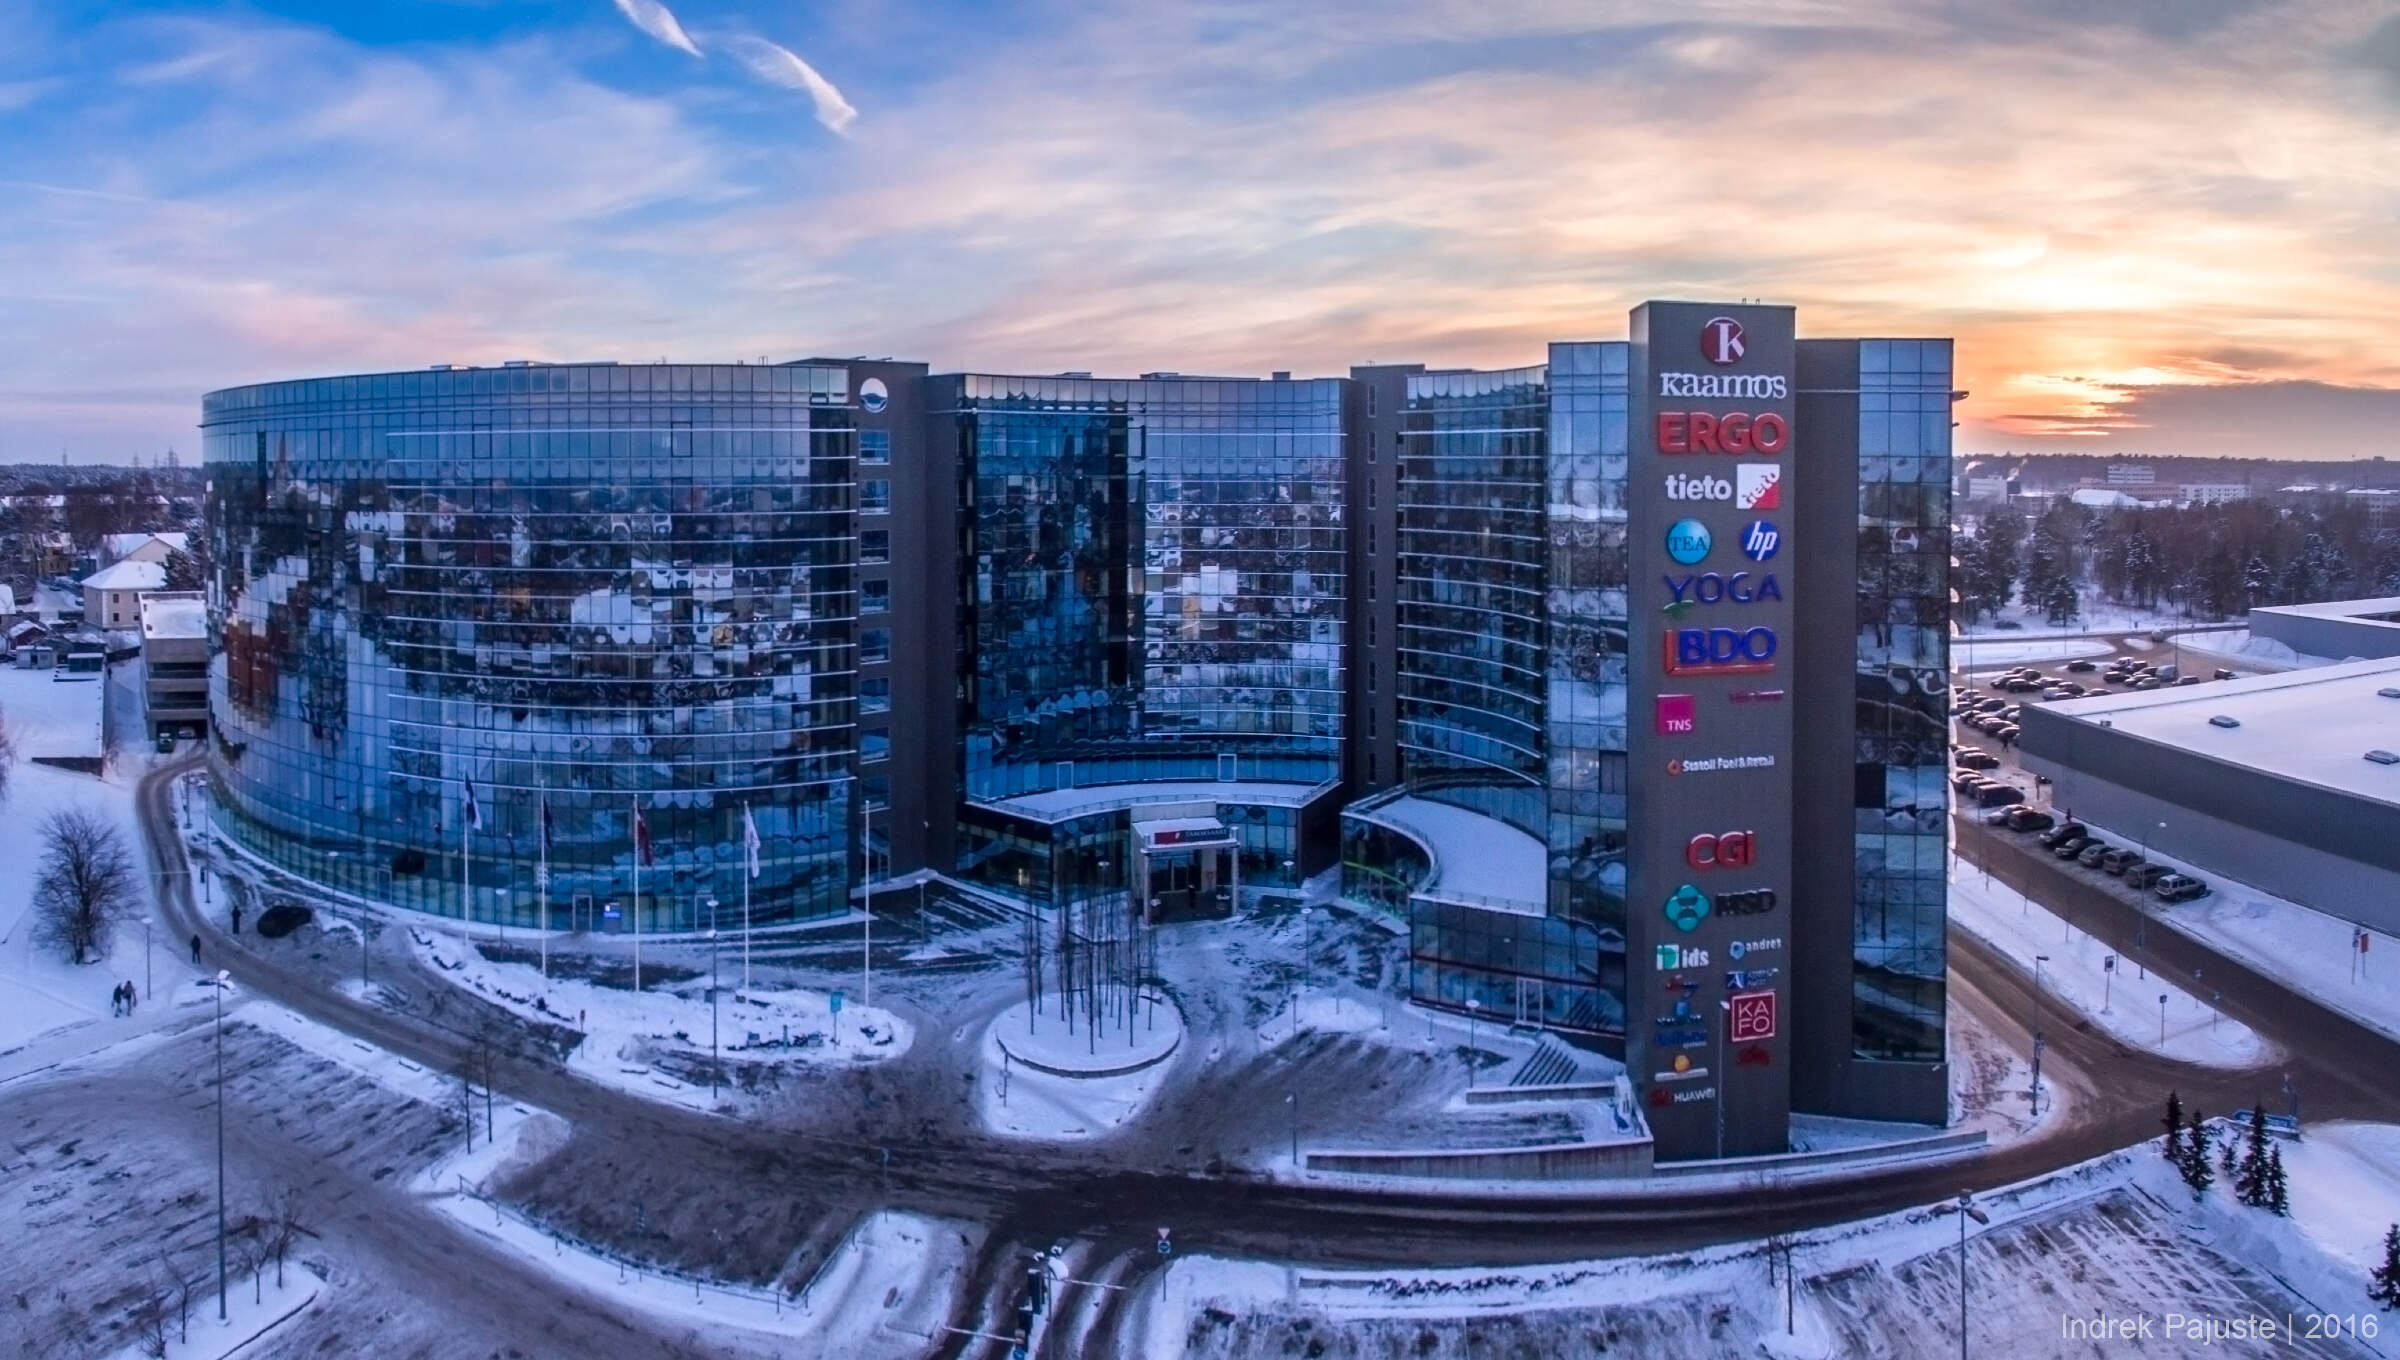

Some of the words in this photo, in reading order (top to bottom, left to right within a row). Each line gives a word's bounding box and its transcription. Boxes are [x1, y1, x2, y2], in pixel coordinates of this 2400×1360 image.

[1657, 411, 1788, 454] ERGO
[1665, 473, 1732, 500] tieto
[1669, 535, 1708, 551] TEA
[1746, 521, 1778, 561] hp
[1663, 572, 1782, 604] YOGA
[1677, 626, 1778, 664] BDO
[1667, 719, 1692, 731] TNS
[1682, 759, 1716, 772] Statoil
[1746, 755, 1775, 767] Retail
[1688, 830, 1756, 870] CGI
[1682, 948, 1710, 969] ids
[1738, 1000, 1770, 1018] KA
[1739, 1016, 1770, 1034] FO
[1674, 1087, 1716, 1103] HUAWEI
